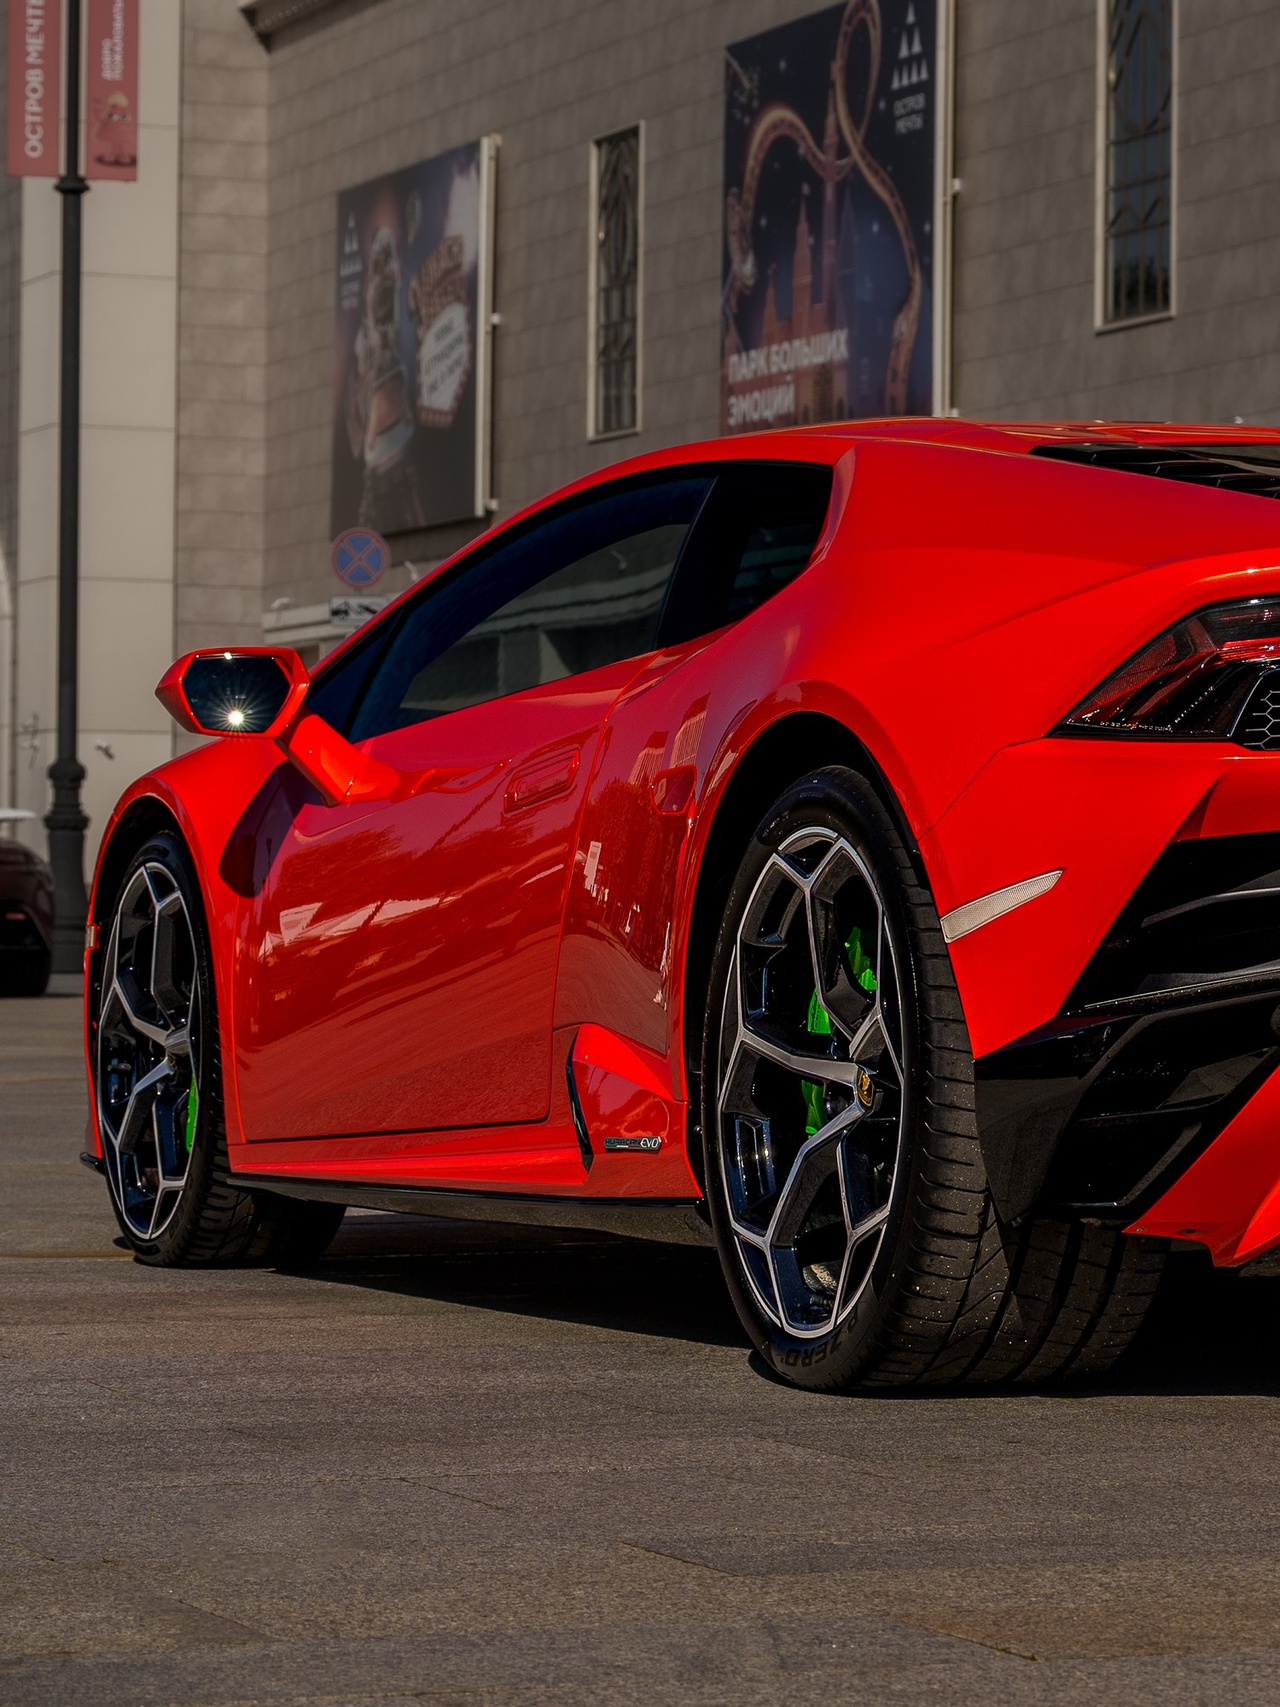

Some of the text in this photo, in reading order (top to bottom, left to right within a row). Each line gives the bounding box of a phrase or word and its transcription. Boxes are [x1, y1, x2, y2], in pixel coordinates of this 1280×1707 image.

[24, 68, 45, 159] ОСТРОВ
[728, 327, 849, 384] ПАРК БОЛЬШИХ
[727, 374, 796, 428] ЭМОЦИЙ
